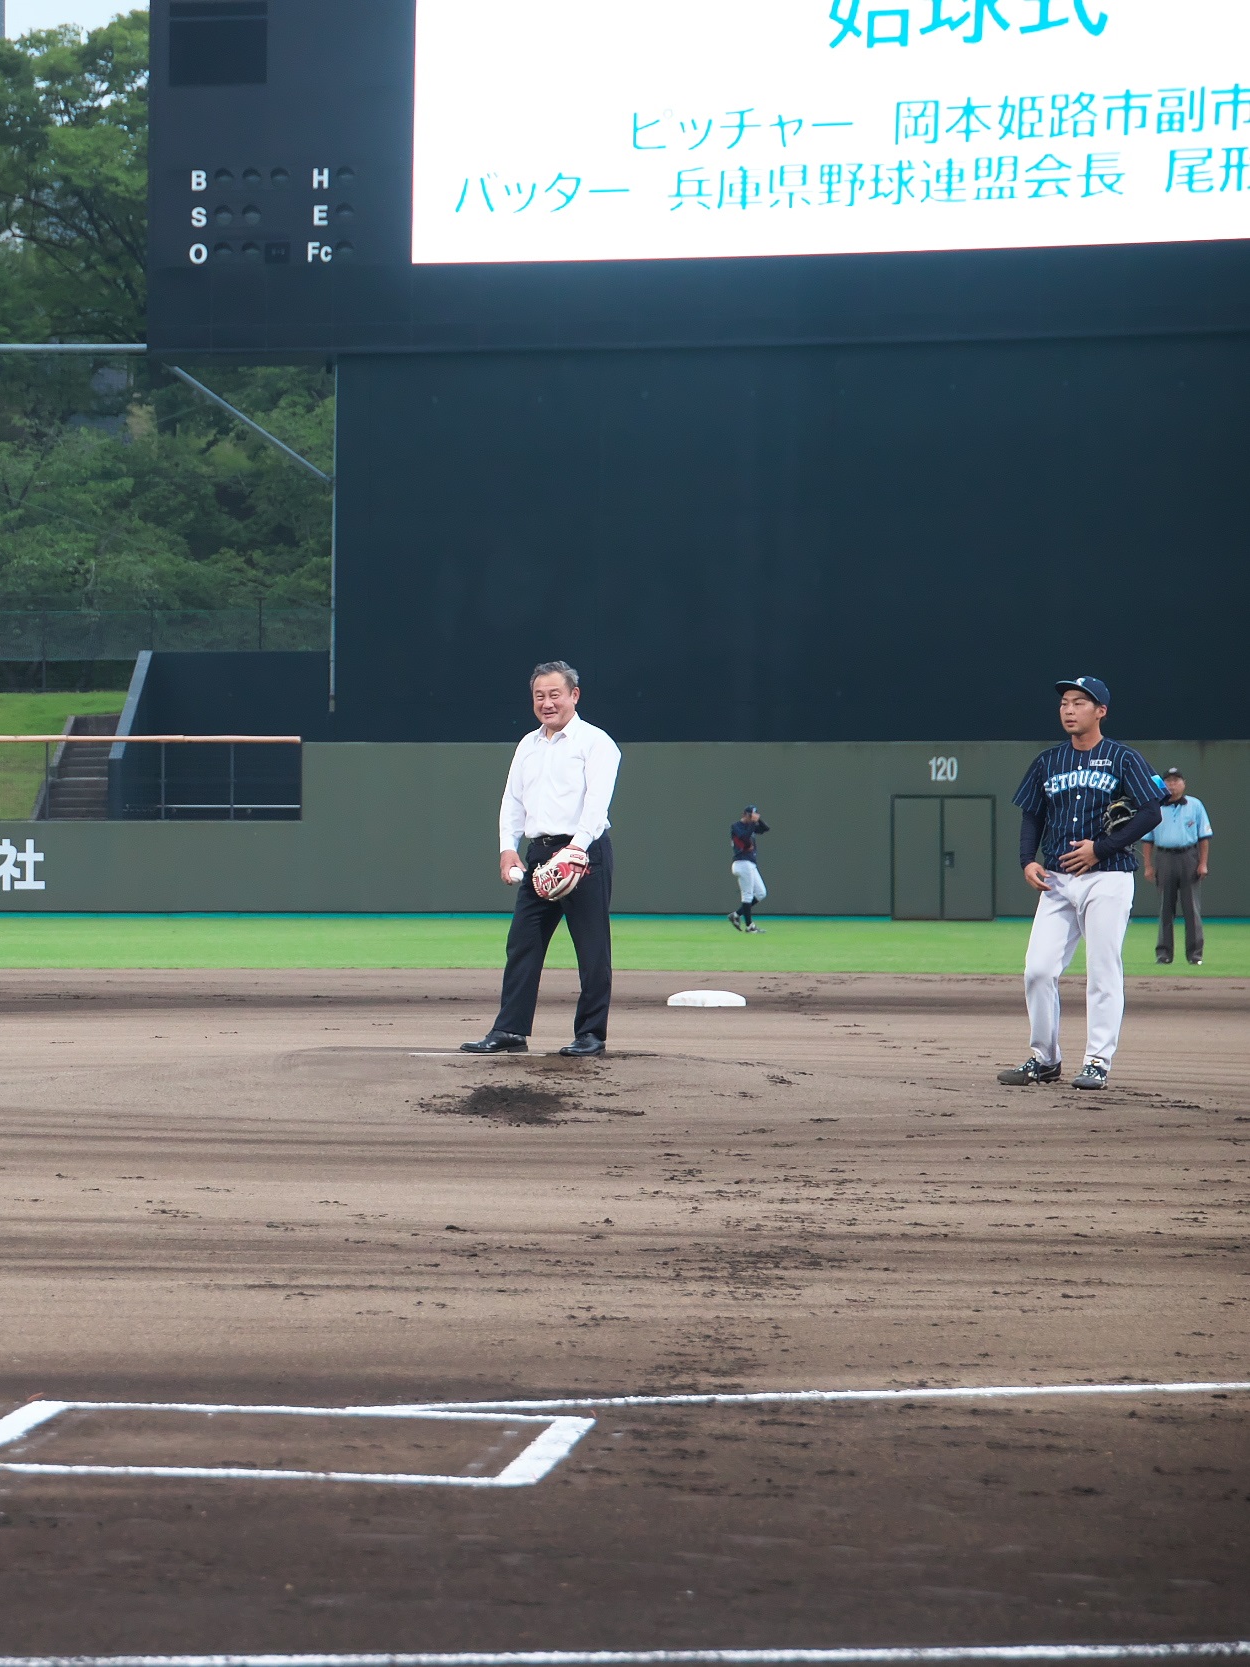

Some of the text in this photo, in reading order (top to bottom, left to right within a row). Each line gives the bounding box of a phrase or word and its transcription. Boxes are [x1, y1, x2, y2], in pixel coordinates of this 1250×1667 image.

[632, 83, 1250, 151] ピッチャー 岡本姫路市副市
[191, 170, 207, 191] B
[312, 168, 329, 189] H
[454, 171, 631, 214] バッター
[667, 152, 1126, 212] 兵庫県野球連盟会長
[191, 207, 207, 227] S
[313, 205, 328, 226] E
[189, 243, 208, 264] O
[307, 242, 333, 262] Fc
[928, 756, 958, 781] 120
